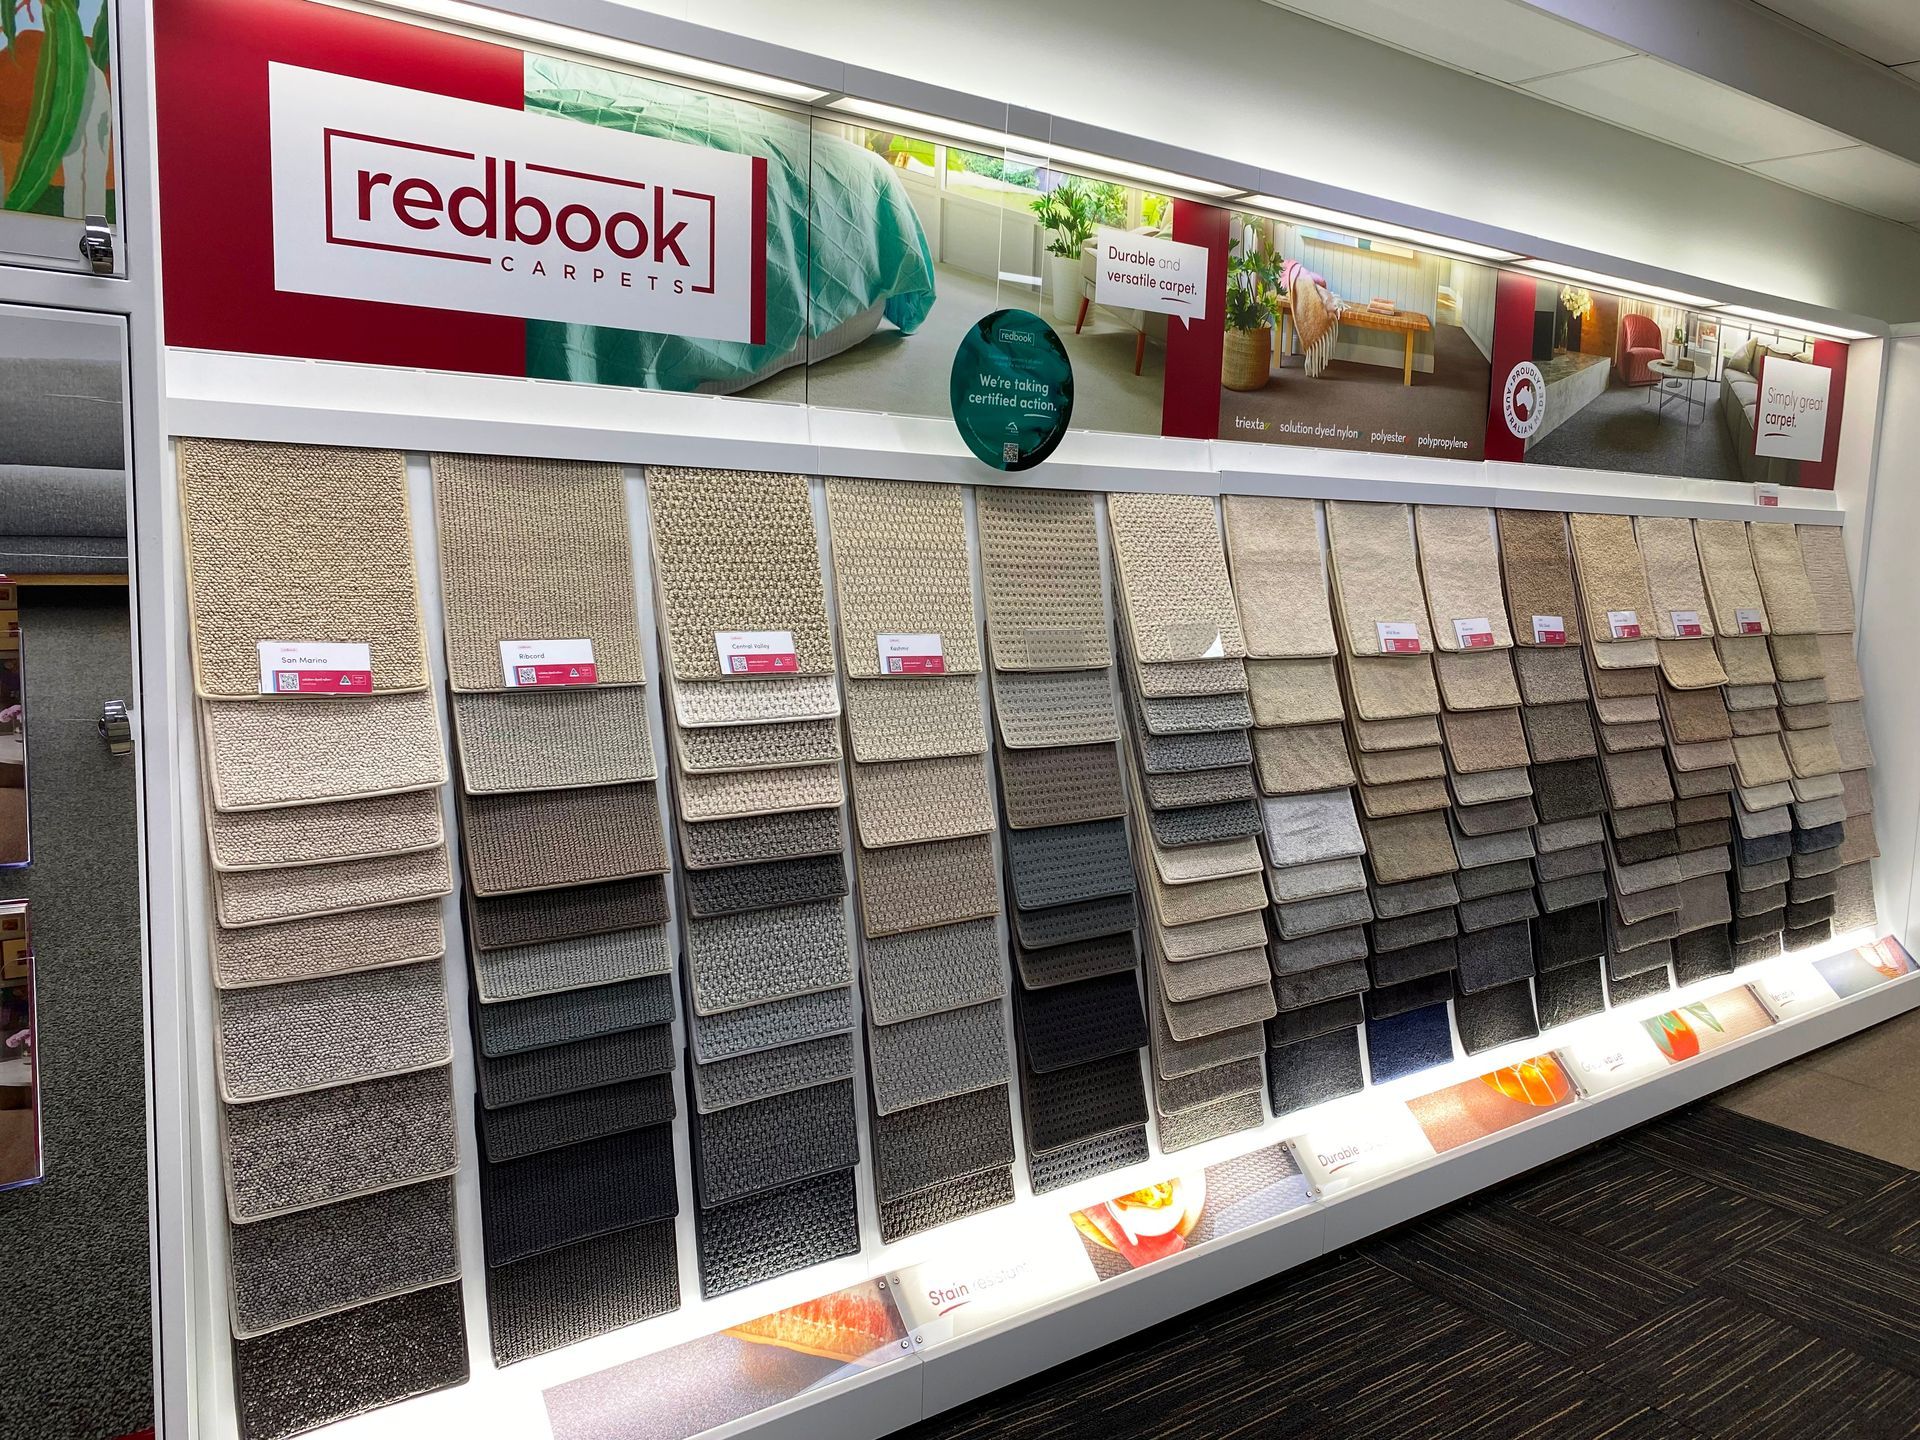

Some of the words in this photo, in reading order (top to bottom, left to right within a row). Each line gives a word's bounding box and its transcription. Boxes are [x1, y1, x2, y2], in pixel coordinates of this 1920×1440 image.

[357, 155, 691, 267] redbook
[1108, 246, 1155, 267] Durable
[1158, 258, 1181, 271] and
[500, 255, 684, 295] CARPETS
[1107, 271, 1157, 288] versatile
[1159, 280, 1197, 296] carpet.
[1001, 331, 1032, 343] redbook
[979, 373, 1011, 389] We're
[1014, 379, 1049, 397] taking
[1511, 367, 1541, 385] PROUDLY
[968, 393, 1017, 407] certified
[1020, 397, 1057, 411] action.
[1767, 386, 1798, 412] Simply
[1799, 397, 1824, 413] great
[1505, 388, 1533, 434] AUSTRALIAN
[1765, 412, 1797, 431] carpet.
[1235, 415, 1265, 430] triexta
[1280, 420, 1313, 435] solution
[1314, 422, 1336, 438] dyed
[1336, 425, 1358, 441] nylon
[1370, 429, 1407, 445] polyester
[1417, 433, 1468, 450] polypropylene
[281, 656, 297, 664] San
[299, 656, 328, 664] Marino
[1317, 1144, 1360, 1167] Durable
[928, 1281, 969, 1306] Stain
